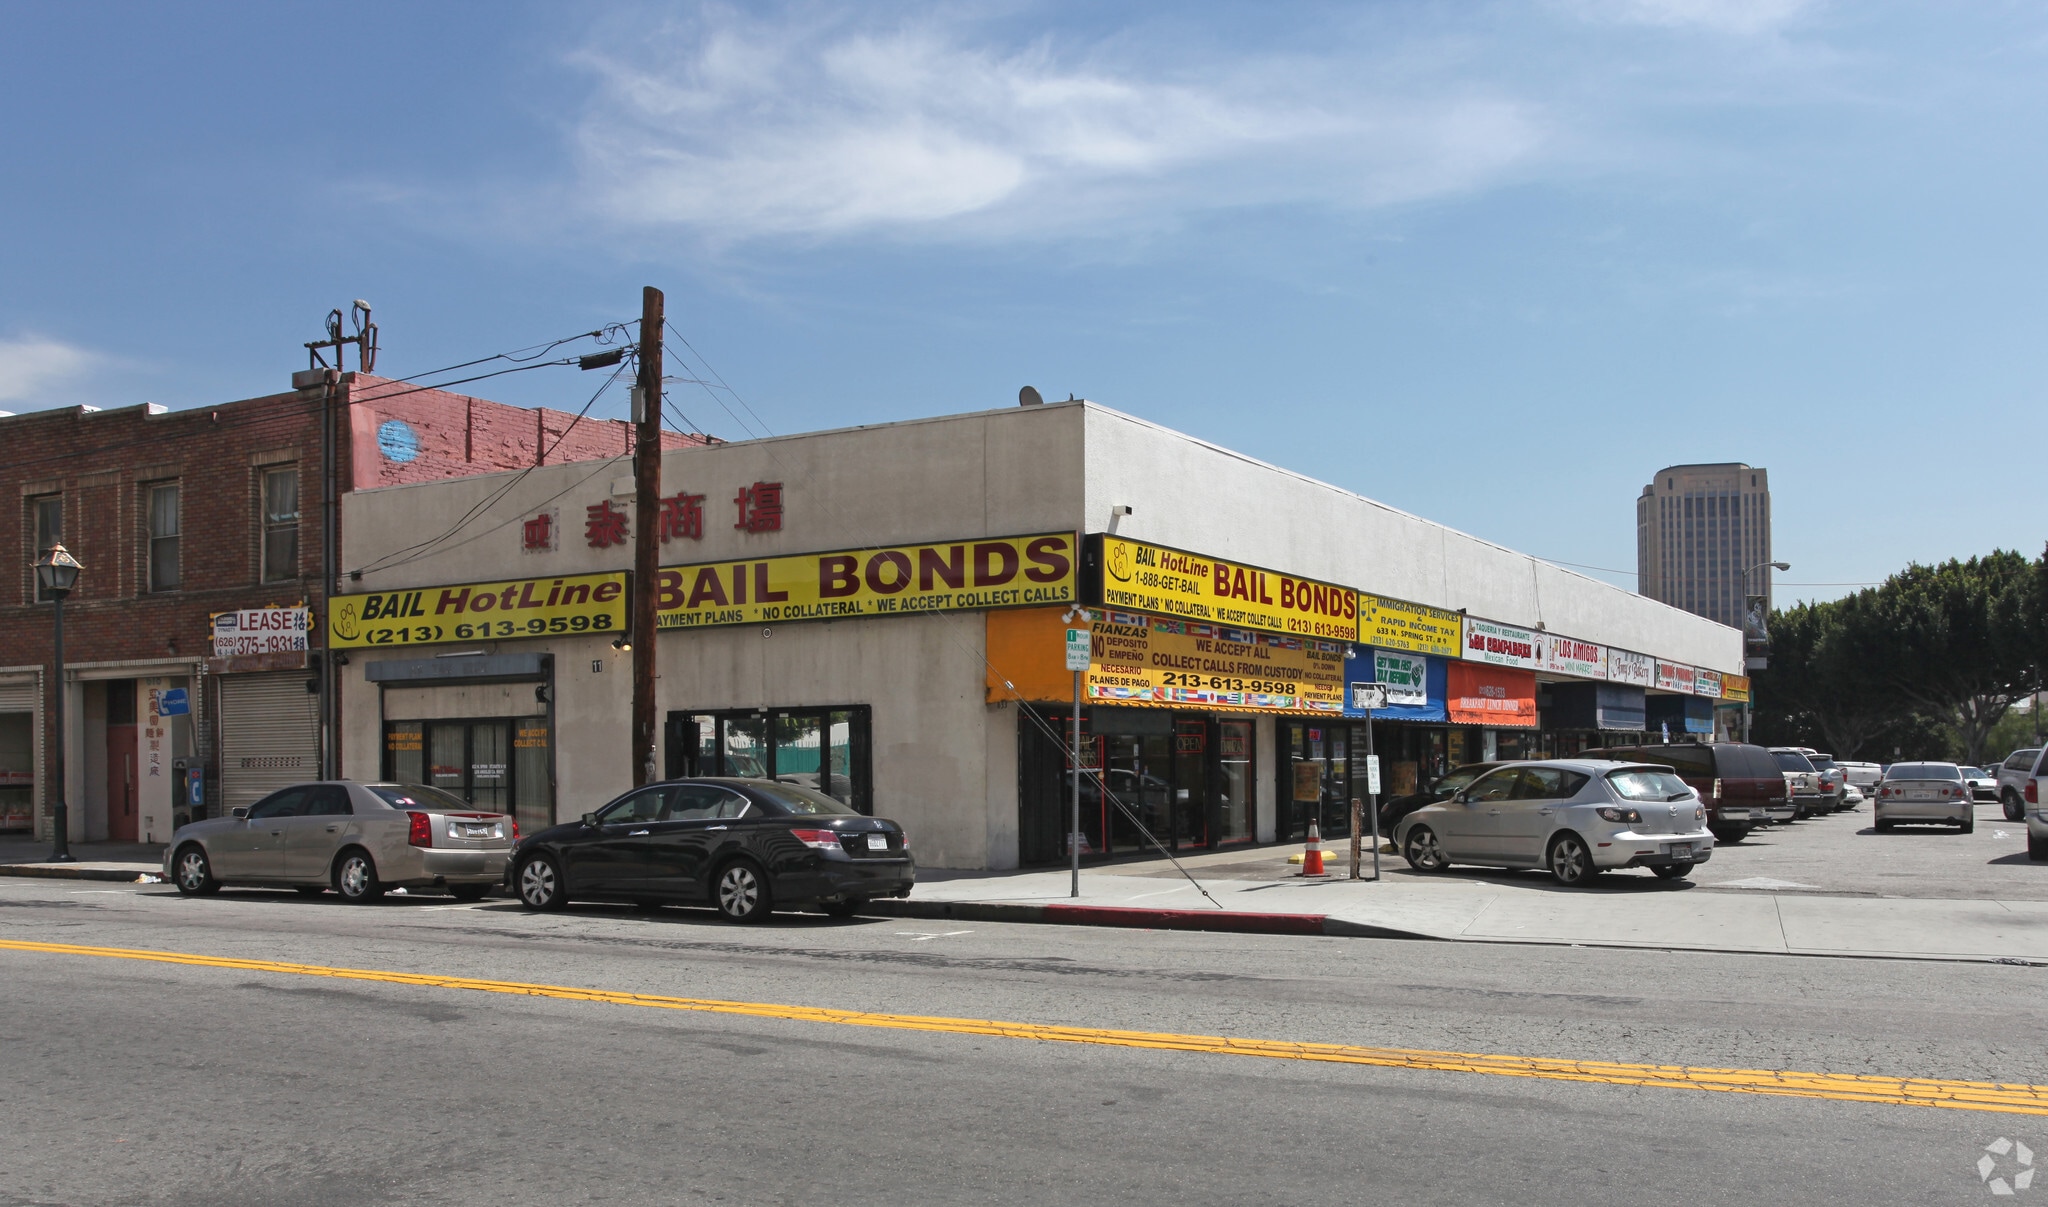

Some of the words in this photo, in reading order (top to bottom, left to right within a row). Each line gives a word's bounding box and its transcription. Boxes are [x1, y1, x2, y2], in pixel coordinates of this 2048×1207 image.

[1135, 546, 1156, 567] BAIL
[1160, 552, 1208, 577] HotLine
[657, 562, 788, 610] BAIL
[819, 537, 1070, 599] BONDS
[1135, 570, 1200, 595] 1-888-GET-BAIL
[361, 592, 425, 620] BAIL
[435, 580, 622, 615] HotLine
[1214, 563, 1273, 605] BAIL
[1281, 578, 1355, 620] BONDS
[656, 612, 702, 627] AYMENT
[705, 609, 743, 624] PLANS
[762, 606, 780, 620] NO
[784, 600, 864, 619] COLLATERAL
[877, 598, 897, 612] WE
[900, 594, 952, 610] ACCEPT
[956, 589, 1019, 607] COLLECT
[1024, 585, 1069, 603] CALLS
[1106, 589, 1137, 606] PAYMENT
[1138, 594, 1159, 610] PLANS
[1164, 598, 1174, 612] NO
[1175, 600, 1211, 618] COLLATERAL
[1217, 607, 1226, 620] WE
[1226, 609, 1246, 624] ACCEPT
[1247, 612, 1266, 627] COLLET
[1267, 616, 1282, 629] CALLS
[1287, 617, 1312, 633] (213)
[1314, 622, 1356, 640] 613-9598
[1377, 598, 1427, 616] IMMIGRATION
[1429, 607, 1459, 623] SERVICES
[240, 612, 292, 631] LEASE
[366, 626, 443, 644] (213)
[455, 614, 613, 640] 613-9598
[1092, 622, 1148, 639] FIANZAS
[1380, 616, 1406, 627] RAPID
[1409, 622, 1438, 633] INCOME
[1440, 627, 1455, 636] TAX
[1376, 627, 1389, 635] 633
[1401, 631, 1424, 641] SPRING
[1426, 635, 1435, 643] ST.
[1476, 623, 1497, 636] TAQUERIA
[1501, 628, 1530, 641] RESTAURANTE
[215, 636, 236, 652] (626)
[237, 635, 293, 655] 375-1931
[1067, 643, 1089, 652] PARKING
[1091, 635, 1104, 658] NO
[1107, 636, 1148, 650] DEPOSITO
[1196, 638, 1212, 652] WE
[1214, 642, 1252, 658] ACCEPT
[1253, 647, 1271, 660] ALL
[1469, 633, 1486, 651] LOS
[1487, 637, 1532, 659] COMPADRES
[1559, 639, 1572, 659] LOS
[1573, 642, 1599, 664] AMIGOS
[1109, 649, 1144, 661] EMPEÑO
[1306, 650, 1320, 660] BAIL
[1321, 653, 1342, 663] BONDS
[1376, 656, 1387, 668] GET
[1484, 652, 1504, 663] Mexican
[1506, 655, 1519, 666] Food
[592, 660, 603, 673] 11
[1100, 663, 1142, 675] NECESARIO
[1152, 653, 1202, 671] COLLECT
[1203, 658, 1235, 674] CALLS
[1237, 662, 1262, 676] FROM
[1264, 665, 1304, 680] CUSTODY
[1321, 663, 1336, 671] DOWN
[1090, 675, 1120, 685] PLANES
[1120, 677, 1131, 686] DE
[1131, 678, 1150, 688] PAGO
[1162, 672, 1296, 695] 213-613-9598
[1304, 671, 1312, 679] NO
[1312, 672, 1343, 682] COLLATERAL
[1304, 691, 1326, 700] PAYMENT
[1327, 692, 1342, 701] PLANS
[1460, 697, 1487, 709] BREAKFAST
[1487, 699, 1502, 710] LUNCH
[1503, 700, 1519, 711] DINNER
[1176, 737, 1200, 750] OPEN
